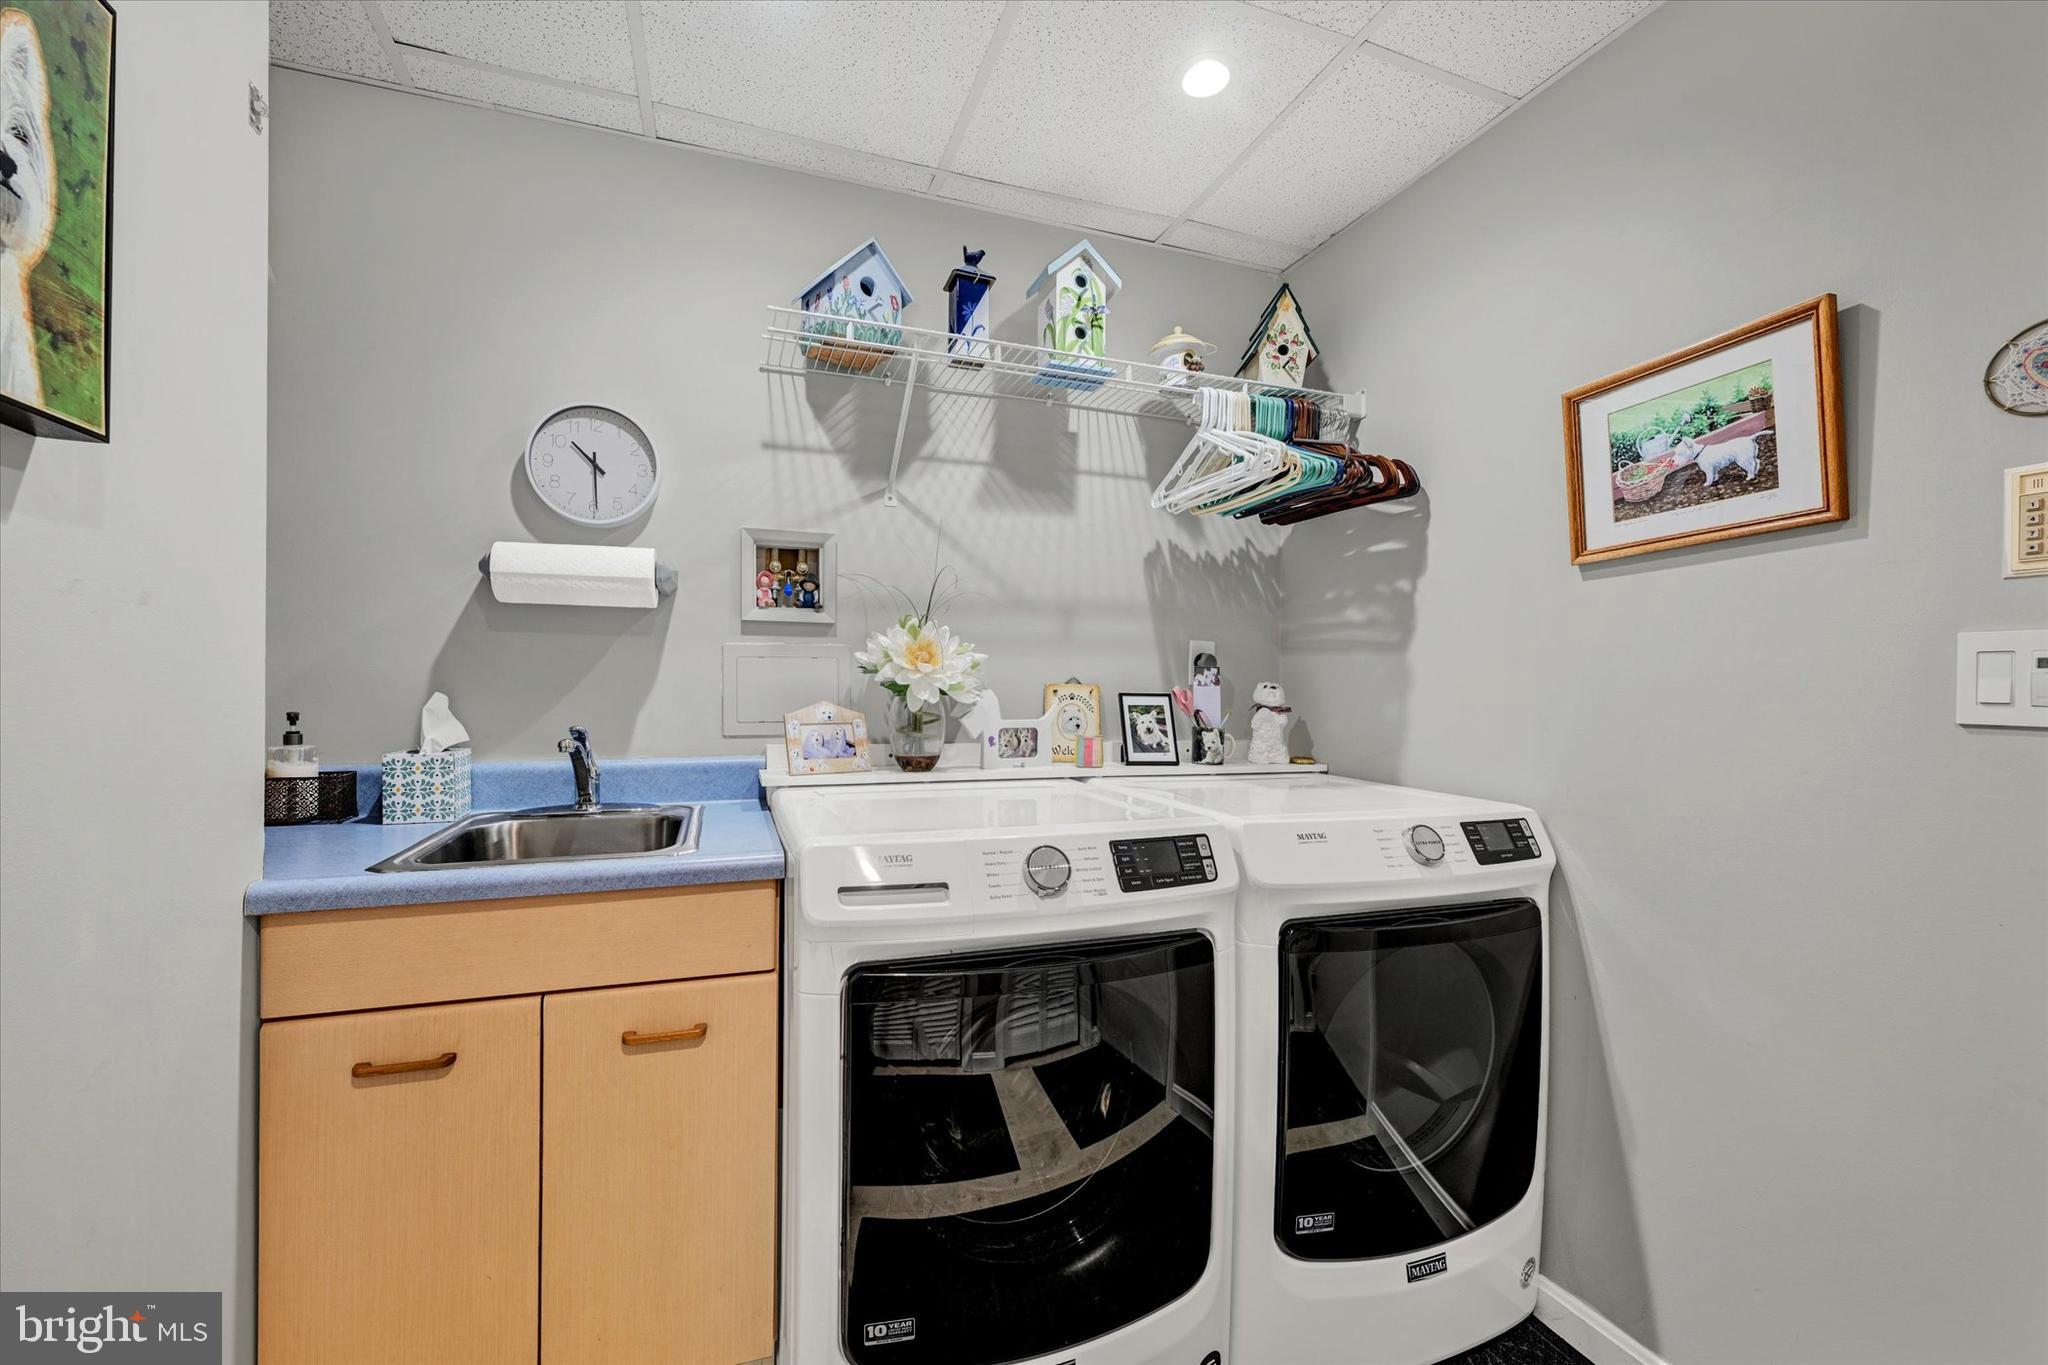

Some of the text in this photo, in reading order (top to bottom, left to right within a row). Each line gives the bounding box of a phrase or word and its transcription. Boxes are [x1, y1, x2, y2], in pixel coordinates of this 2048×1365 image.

[567, 420, 580, 433] 11
[590, 418, 603, 433] 12
[550, 433, 567, 448] 10
[630, 442, 640, 457] 2
[542, 453, 554, 468] 9
[637, 464, 648, 478] 3
[549, 474, 561, 489] 8
[628, 483, 639, 497] 4
[566, 491, 577, 505] 7
[612, 496, 623, 511] 5
[1052, 744, 1076, 756] Welc
[1299, 1217, 1314, 1228] 10
[1411, 1260, 1446, 1278] MAYTAG
[867, 1325, 887, 1338] 10
